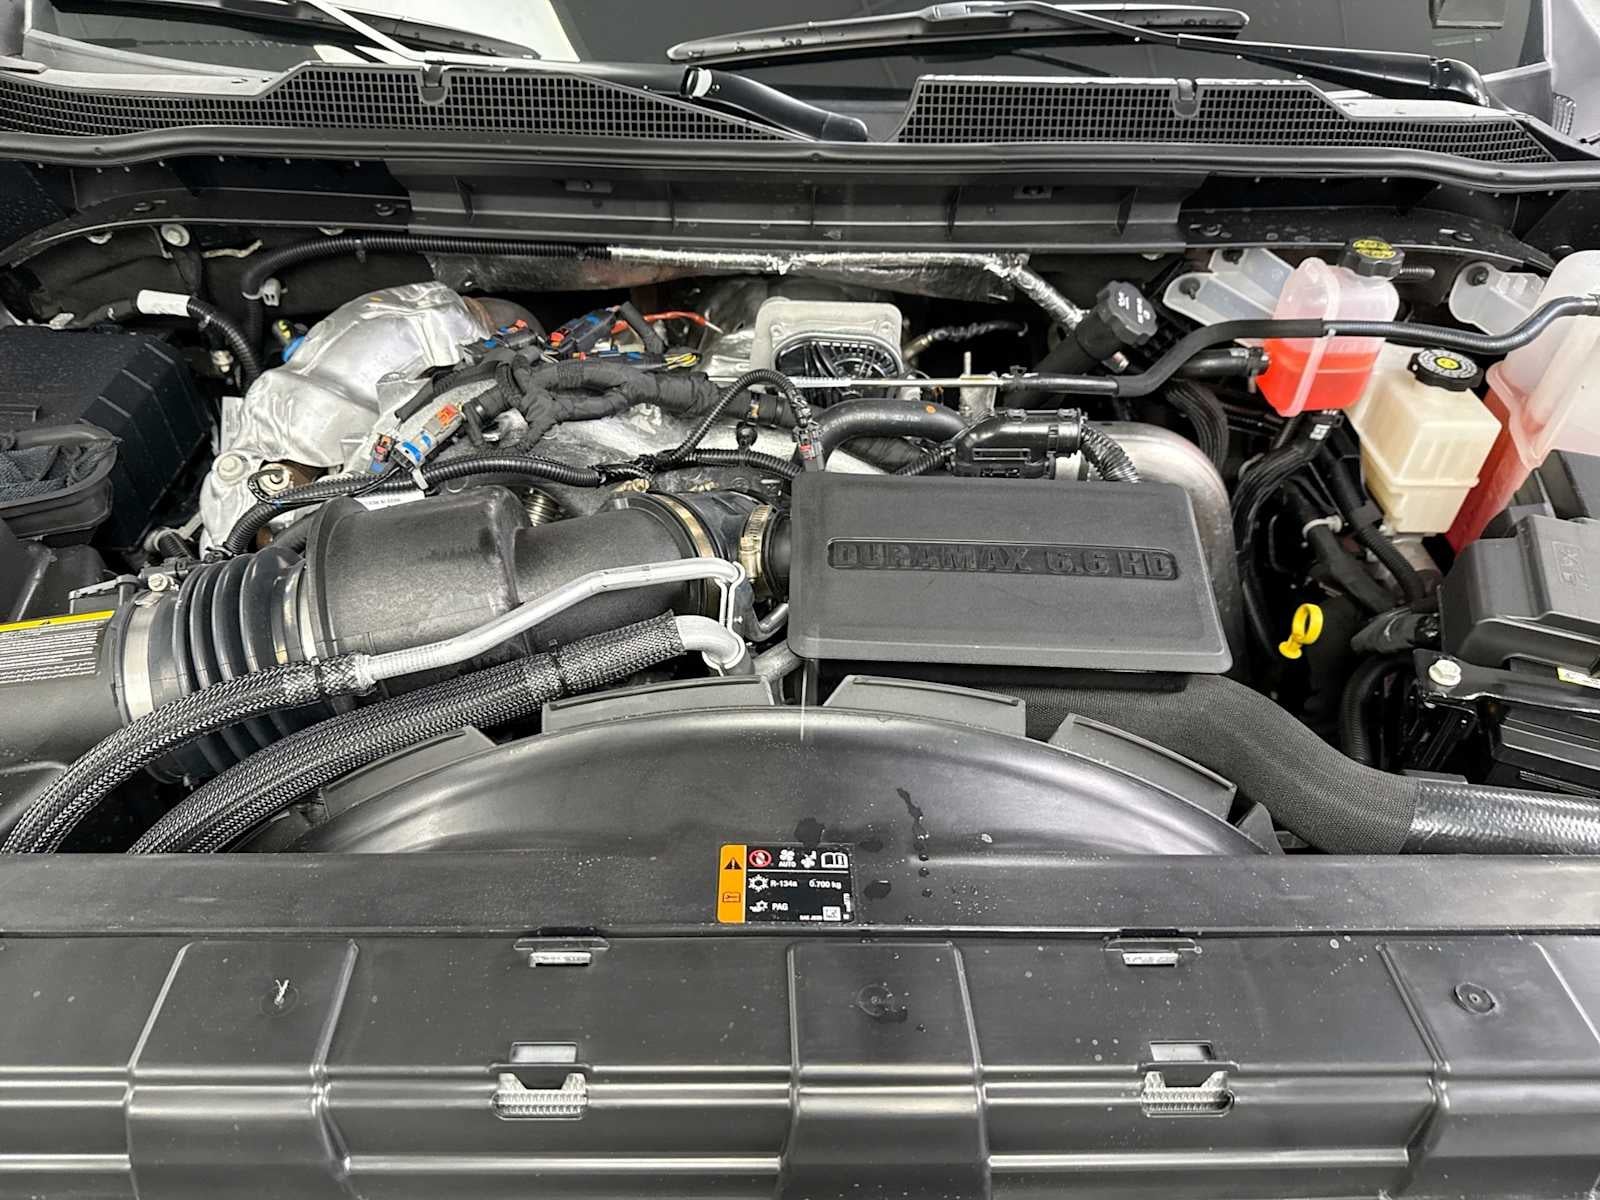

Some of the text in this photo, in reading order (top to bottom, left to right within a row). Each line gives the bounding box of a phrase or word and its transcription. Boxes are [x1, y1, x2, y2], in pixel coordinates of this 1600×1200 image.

[832, 541, 1178, 579] DURAMAX 6.6 HD
[770, 879, 798, 888] R-134a
[831, 881, 842, 890] kg
[771, 902, 789, 911] PAG
